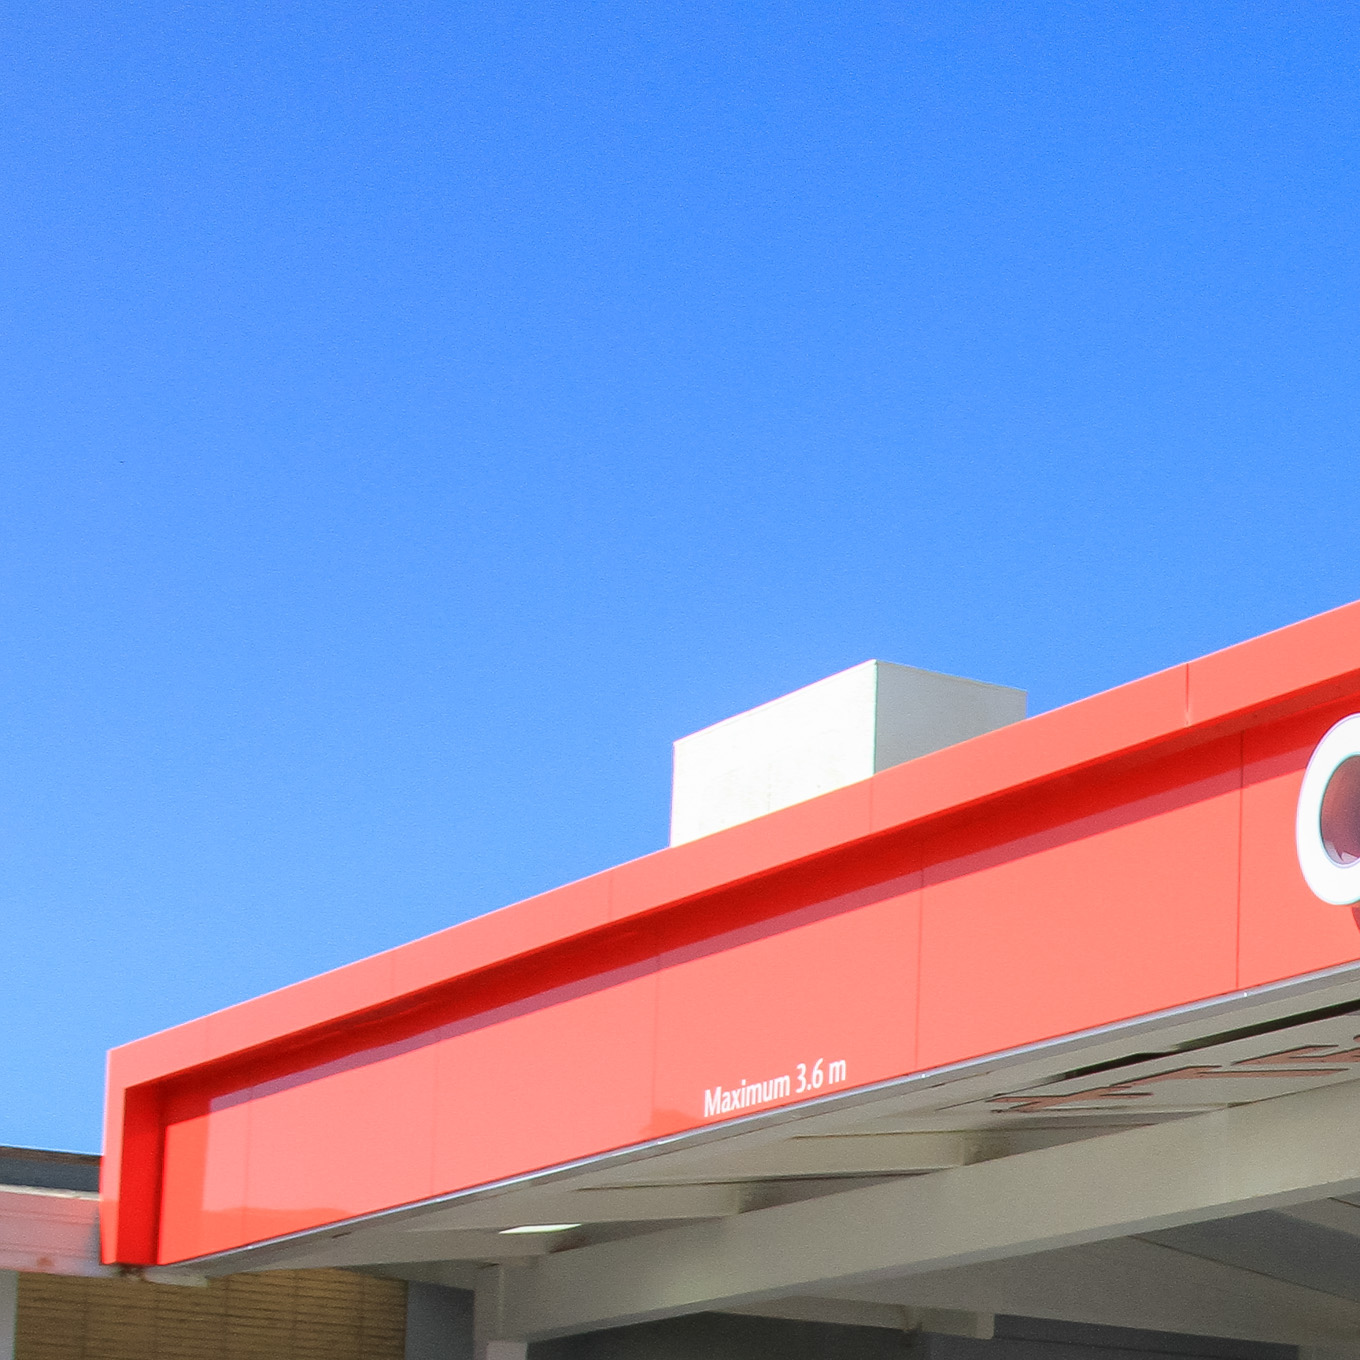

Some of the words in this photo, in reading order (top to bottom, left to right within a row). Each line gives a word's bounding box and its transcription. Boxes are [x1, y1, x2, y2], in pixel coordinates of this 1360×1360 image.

[703, 1075, 790, 1118] Maximum
[795, 1058, 823, 1094] 3.6
[828, 1059, 846, 1084] m
